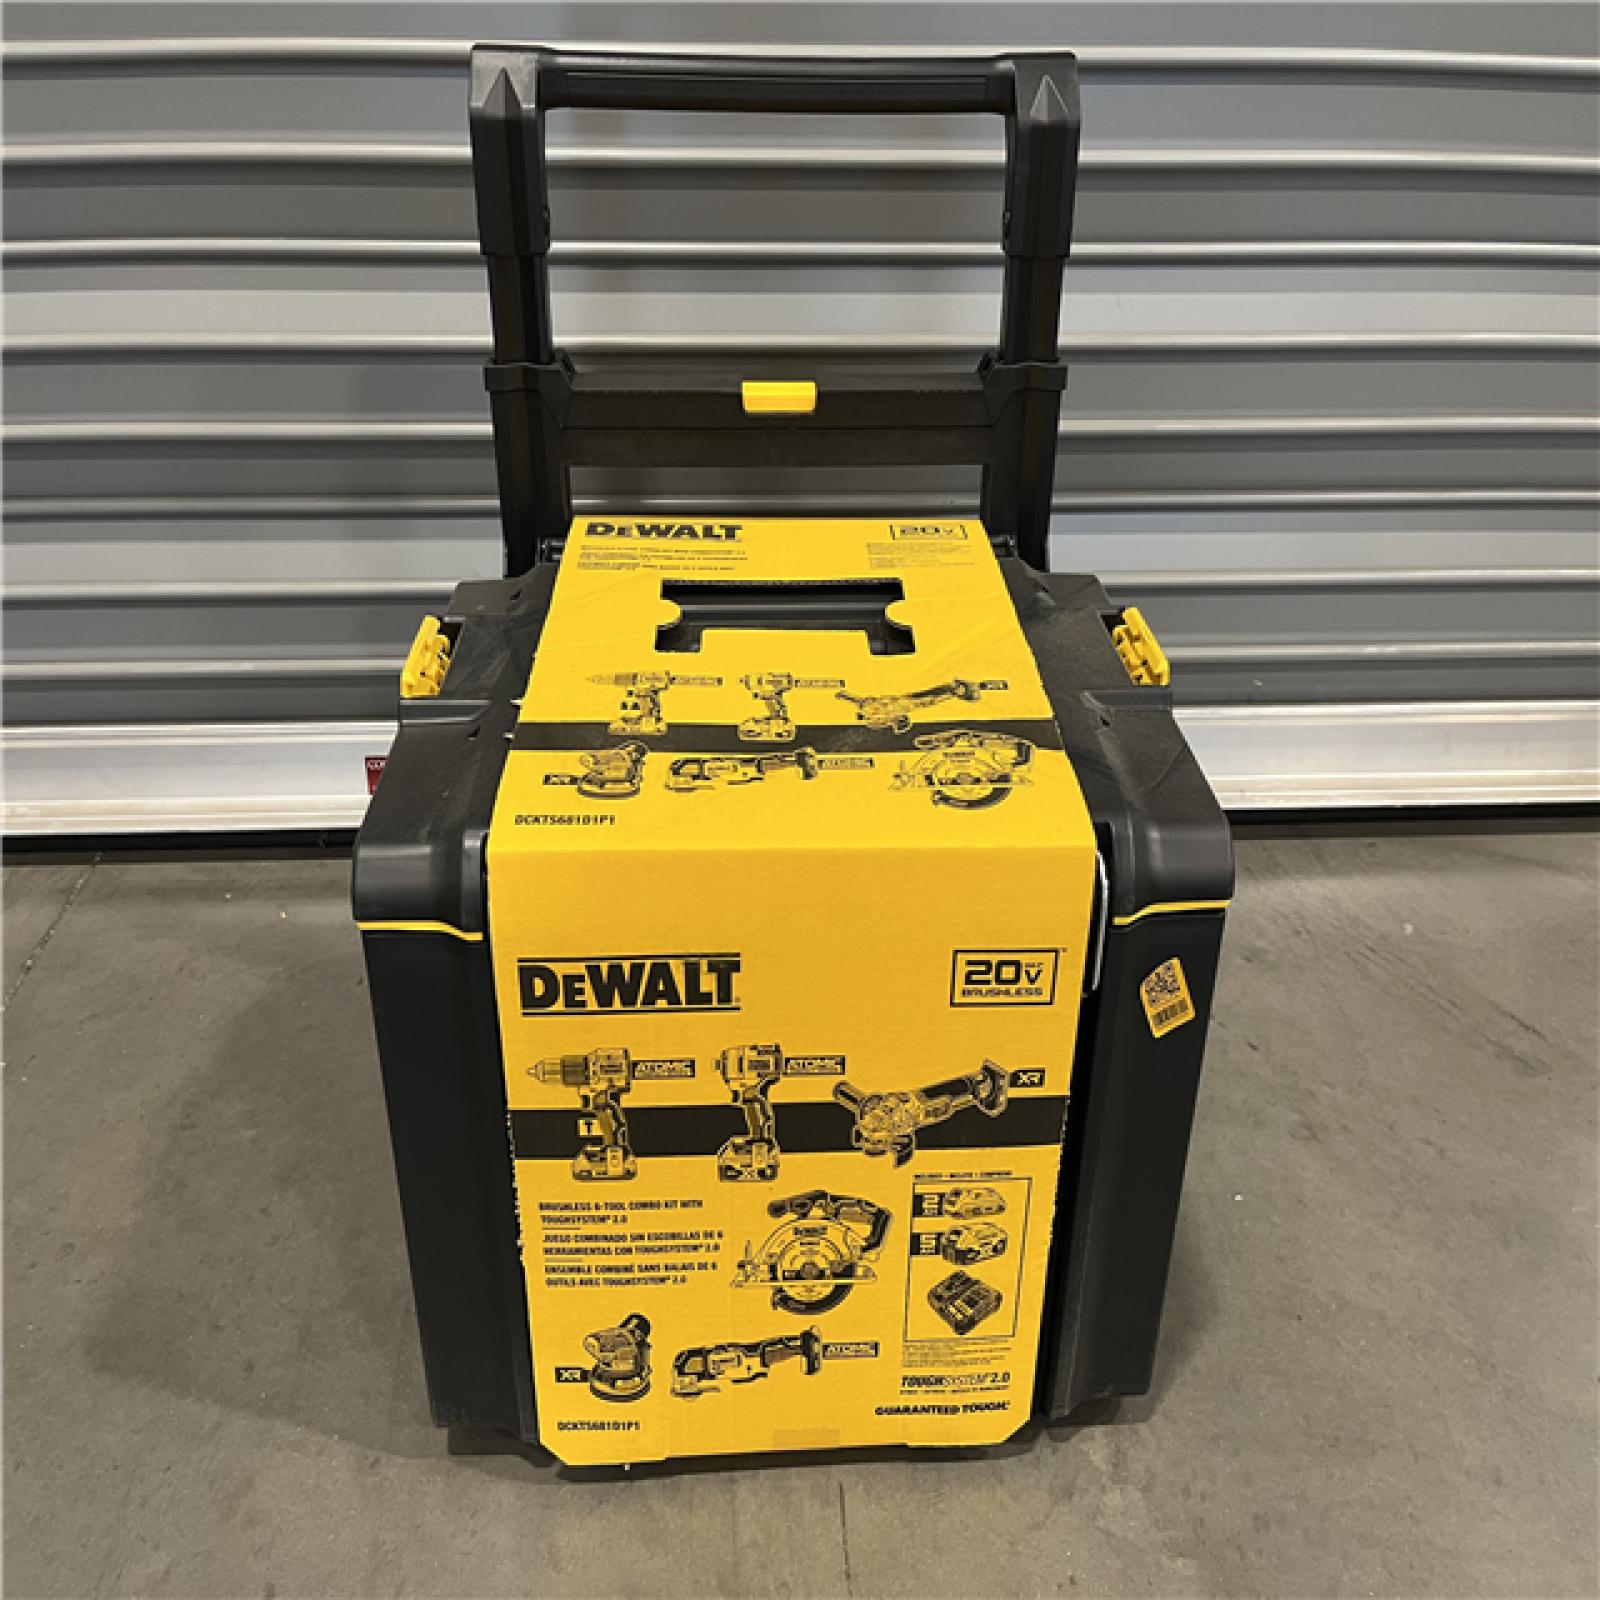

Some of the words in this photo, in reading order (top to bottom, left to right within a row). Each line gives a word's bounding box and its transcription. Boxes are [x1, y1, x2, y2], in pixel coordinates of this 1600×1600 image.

[585, 522, 743, 540] DEWALT
[518, 958, 741, 1009] DEWALT
[874, 1404, 961, 1416] GUARANTEED
